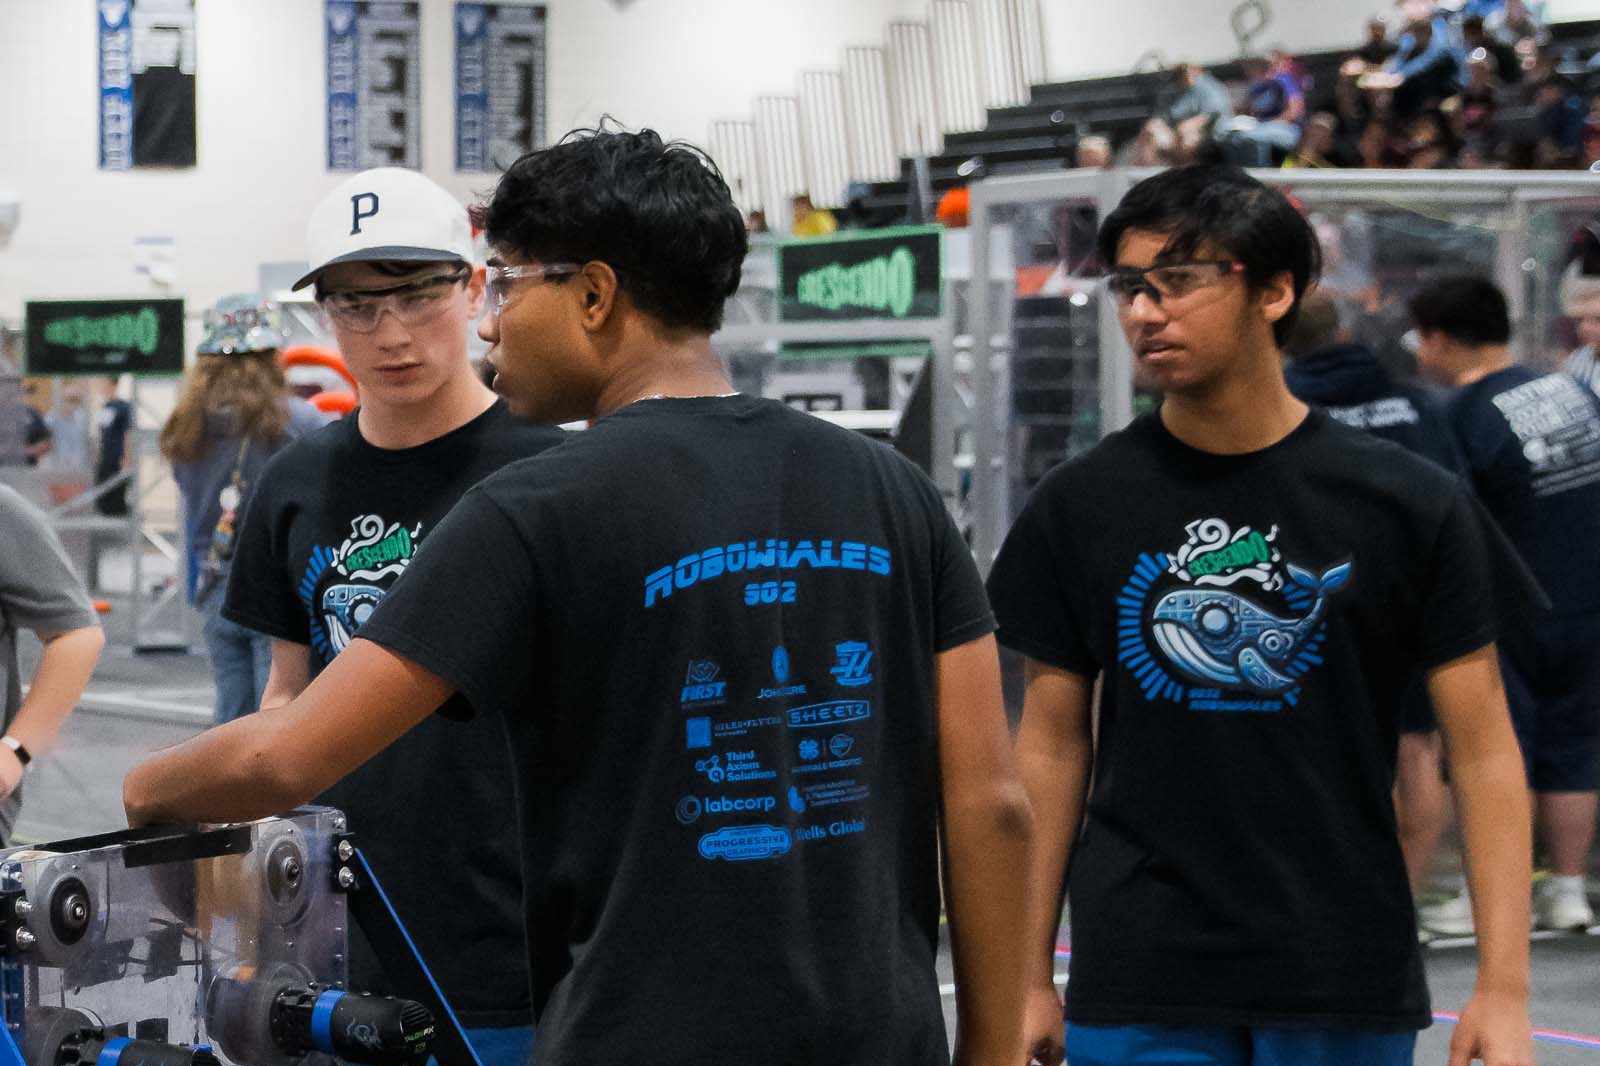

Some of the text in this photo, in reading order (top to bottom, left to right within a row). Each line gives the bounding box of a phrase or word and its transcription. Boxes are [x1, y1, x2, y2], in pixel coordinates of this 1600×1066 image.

[350, 192, 379, 235] P
[790, 703, 865, 724] SHEETZ
[726, 751, 754, 764] Third
[726, 762, 760, 773] Axiom
[726, 770, 777, 782] Solutions
[705, 796, 776, 813] labcorp
[705, 835, 785, 848] PROGRESSIVE
